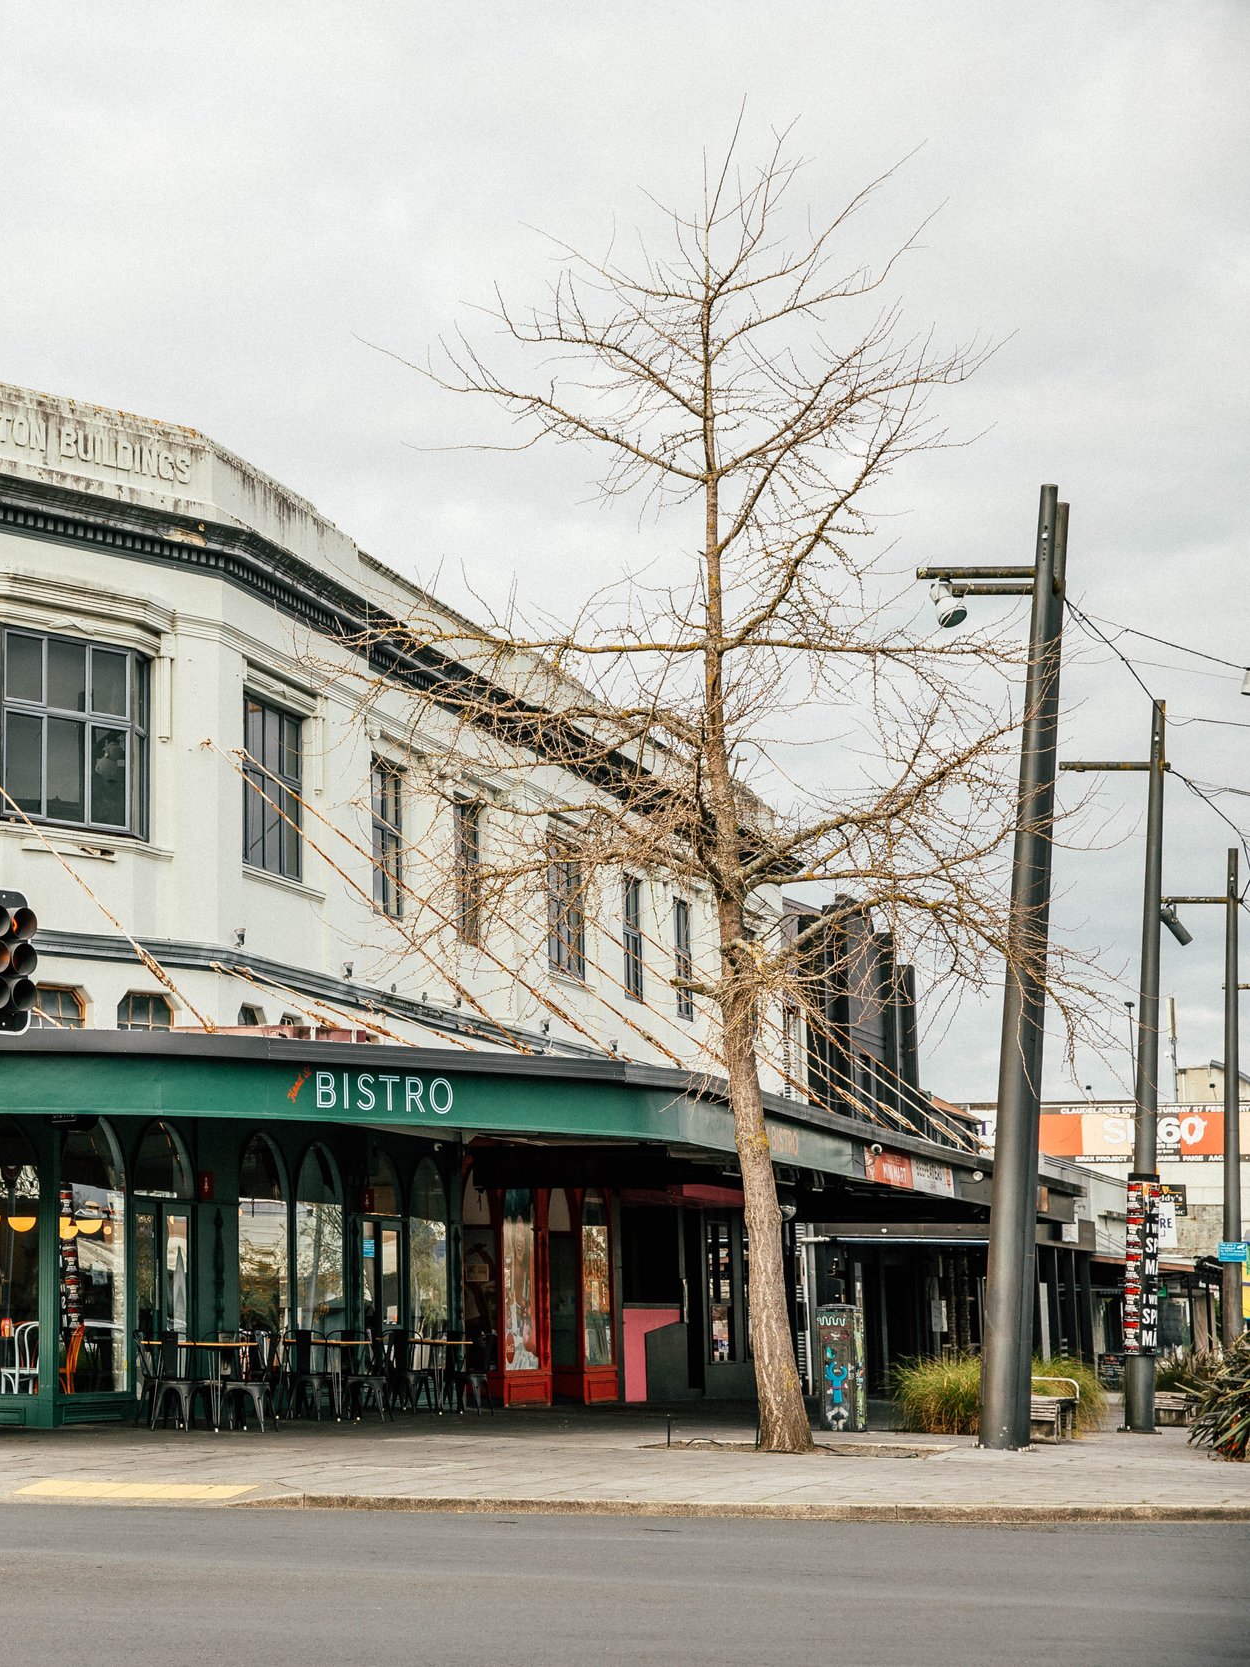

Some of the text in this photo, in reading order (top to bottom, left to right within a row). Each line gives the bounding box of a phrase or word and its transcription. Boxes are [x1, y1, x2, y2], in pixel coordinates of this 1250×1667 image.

[60, 426, 191, 484] BUILDINGS
[316, 1071, 454, 1115] BISTRO
[1060, 1107, 1120, 1115] CLAUDELANDS
[771, 1126, 799, 1156] BISTRO
